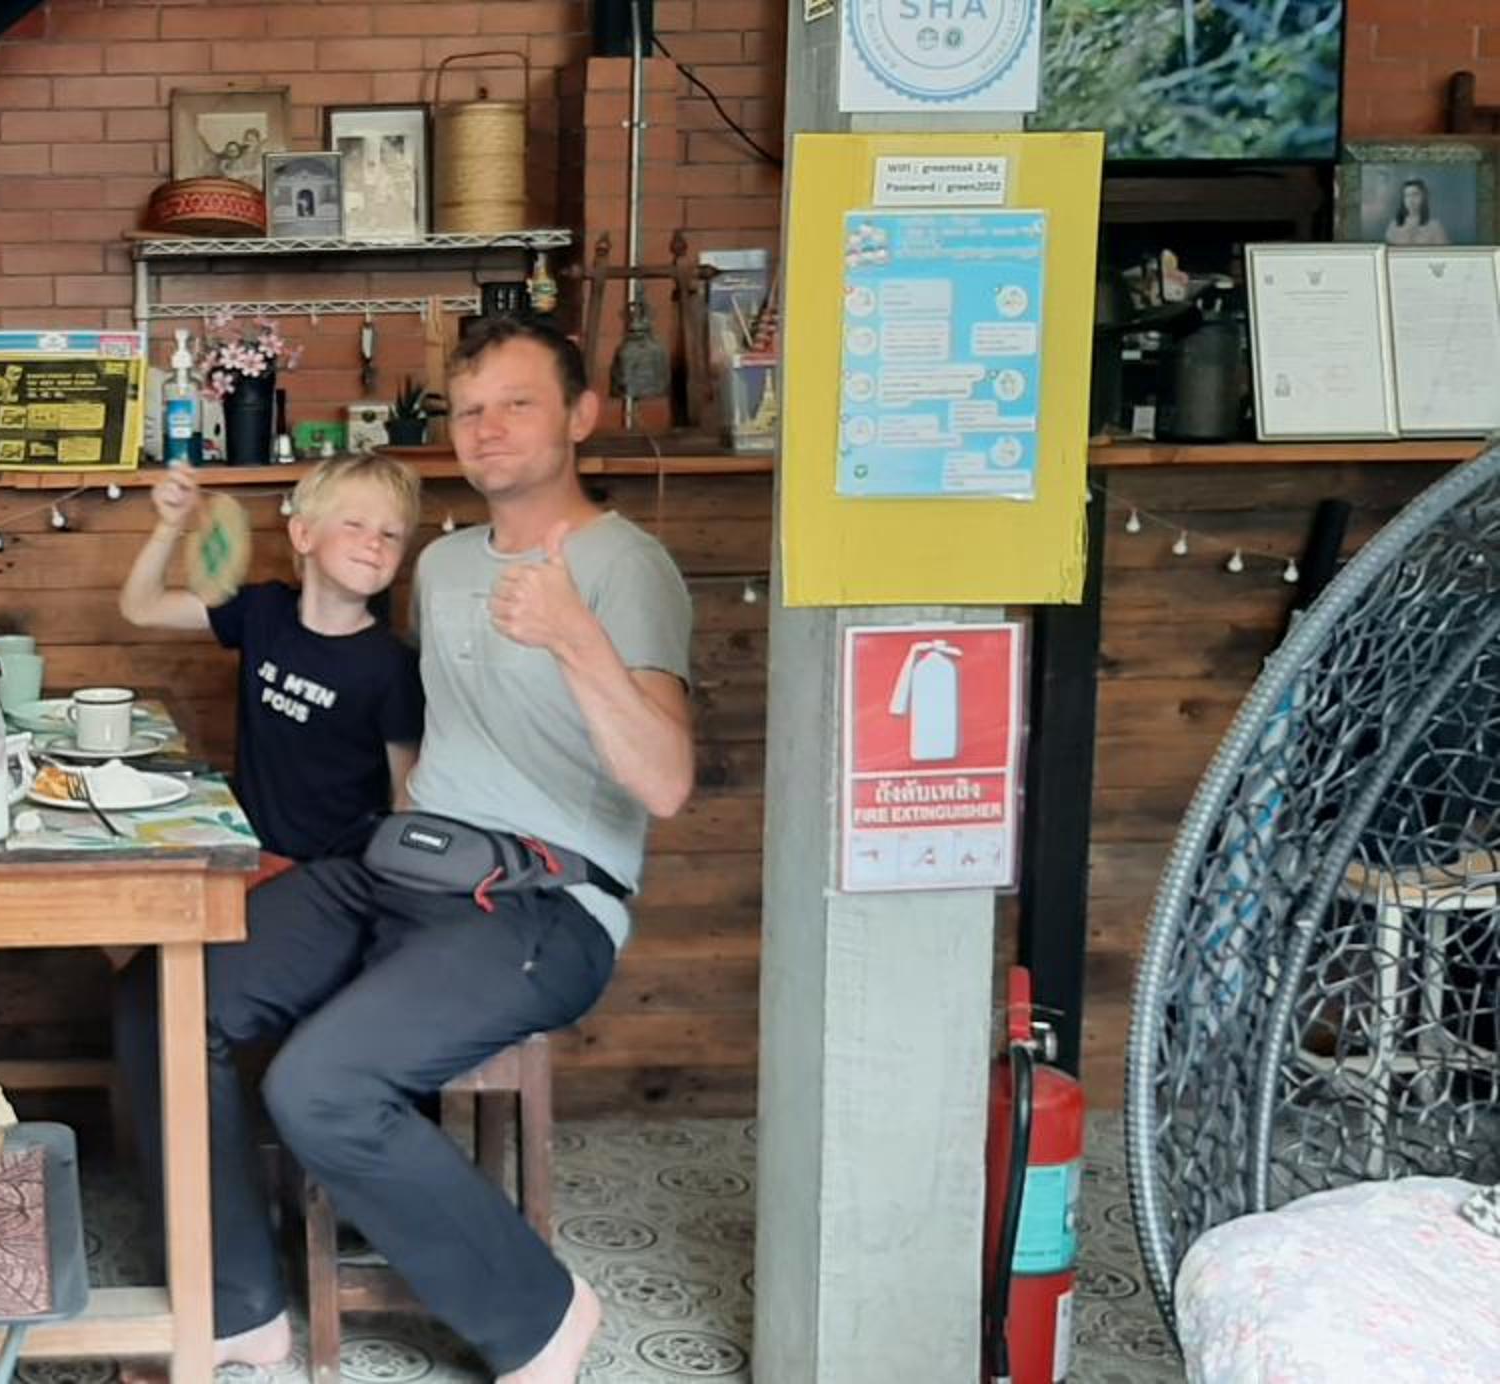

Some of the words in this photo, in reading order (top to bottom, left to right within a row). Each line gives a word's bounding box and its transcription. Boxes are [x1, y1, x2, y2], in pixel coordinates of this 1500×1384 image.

[886, 182, 935, 194] Password
[257, 660, 279, 683] JE
[261, 687, 310, 723] FOUS
[853, 806, 890, 824] FIRE
[891, 801, 1002, 821] EXTINGUISHER
